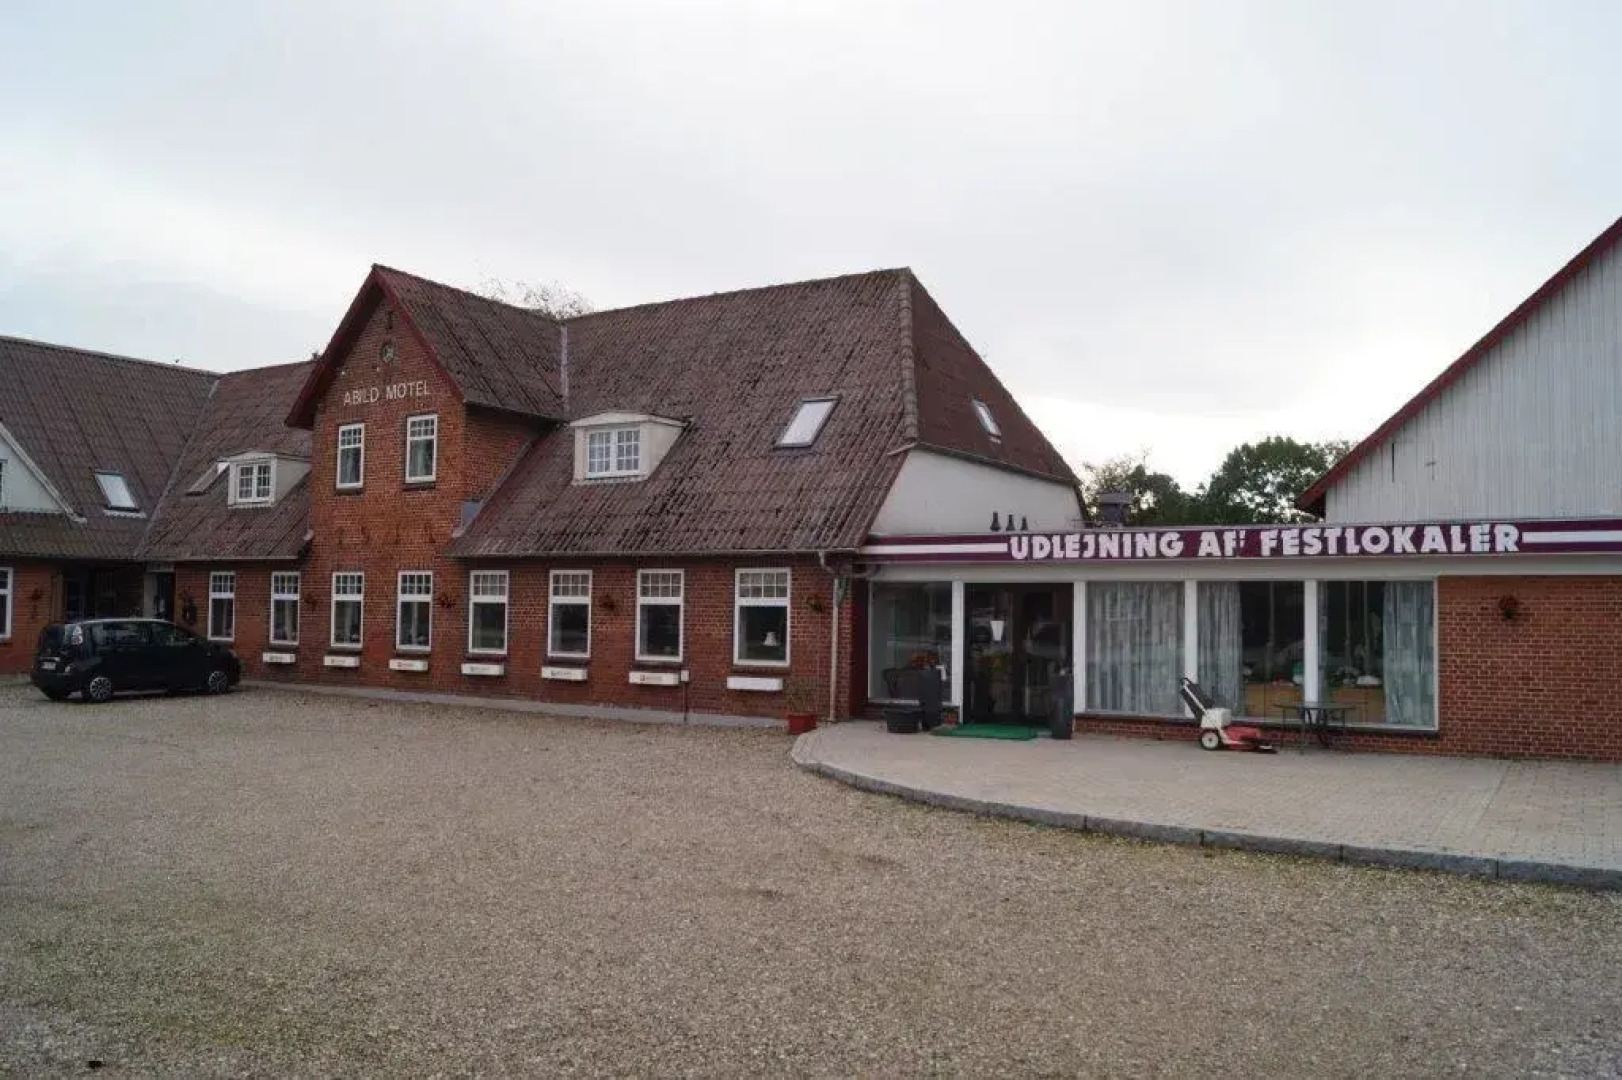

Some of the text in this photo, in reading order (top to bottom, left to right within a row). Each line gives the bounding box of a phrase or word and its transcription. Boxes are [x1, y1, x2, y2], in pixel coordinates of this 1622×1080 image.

[343, 380, 431, 406] ABILD MOTEL
[1010, 531, 1184, 560] UDLEJNING
[1260, 523, 1519, 557] FESTLOKALER
